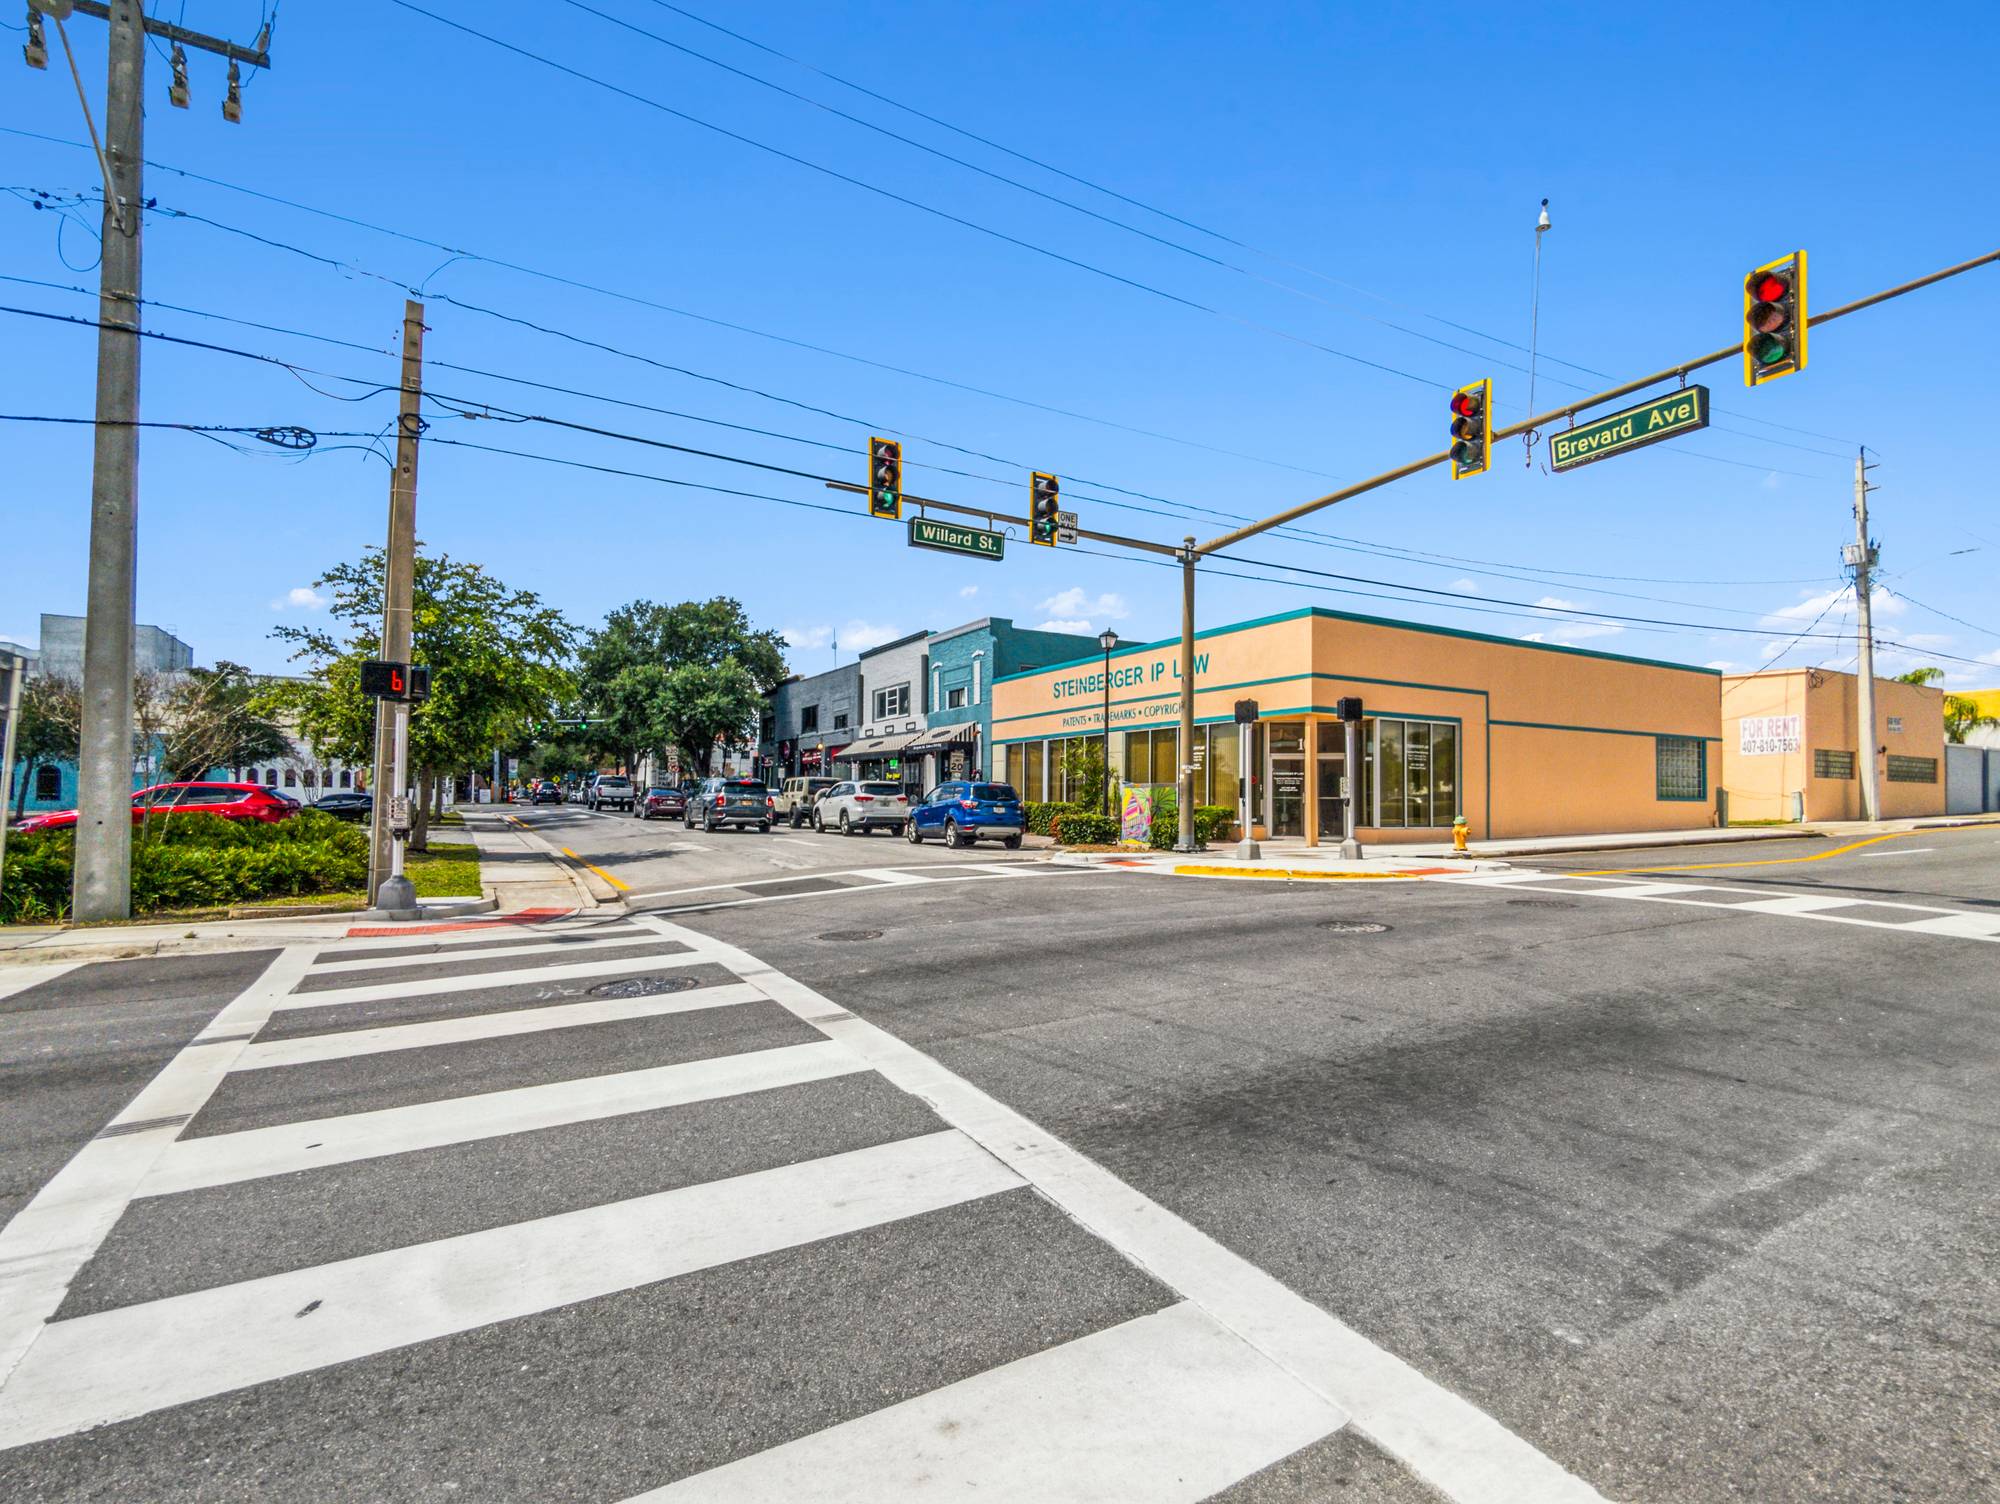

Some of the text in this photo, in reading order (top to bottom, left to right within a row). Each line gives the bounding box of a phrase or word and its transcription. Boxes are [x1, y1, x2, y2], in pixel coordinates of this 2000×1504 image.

[1557, 403, 1691, 459] Brevard Ave
[1060, 513, 1076, 523] ONE
[922, 525, 998, 551] Willard St.
[1053, 653, 1209, 699] STEINBERGER IP LW
[1062, 715, 1087, 728] PATENTS
[1093, 708, 1137, 723] TRAEMARKS
[1742, 717, 1797, 738] FOR RENT
[951, 762, 964, 771] 20
